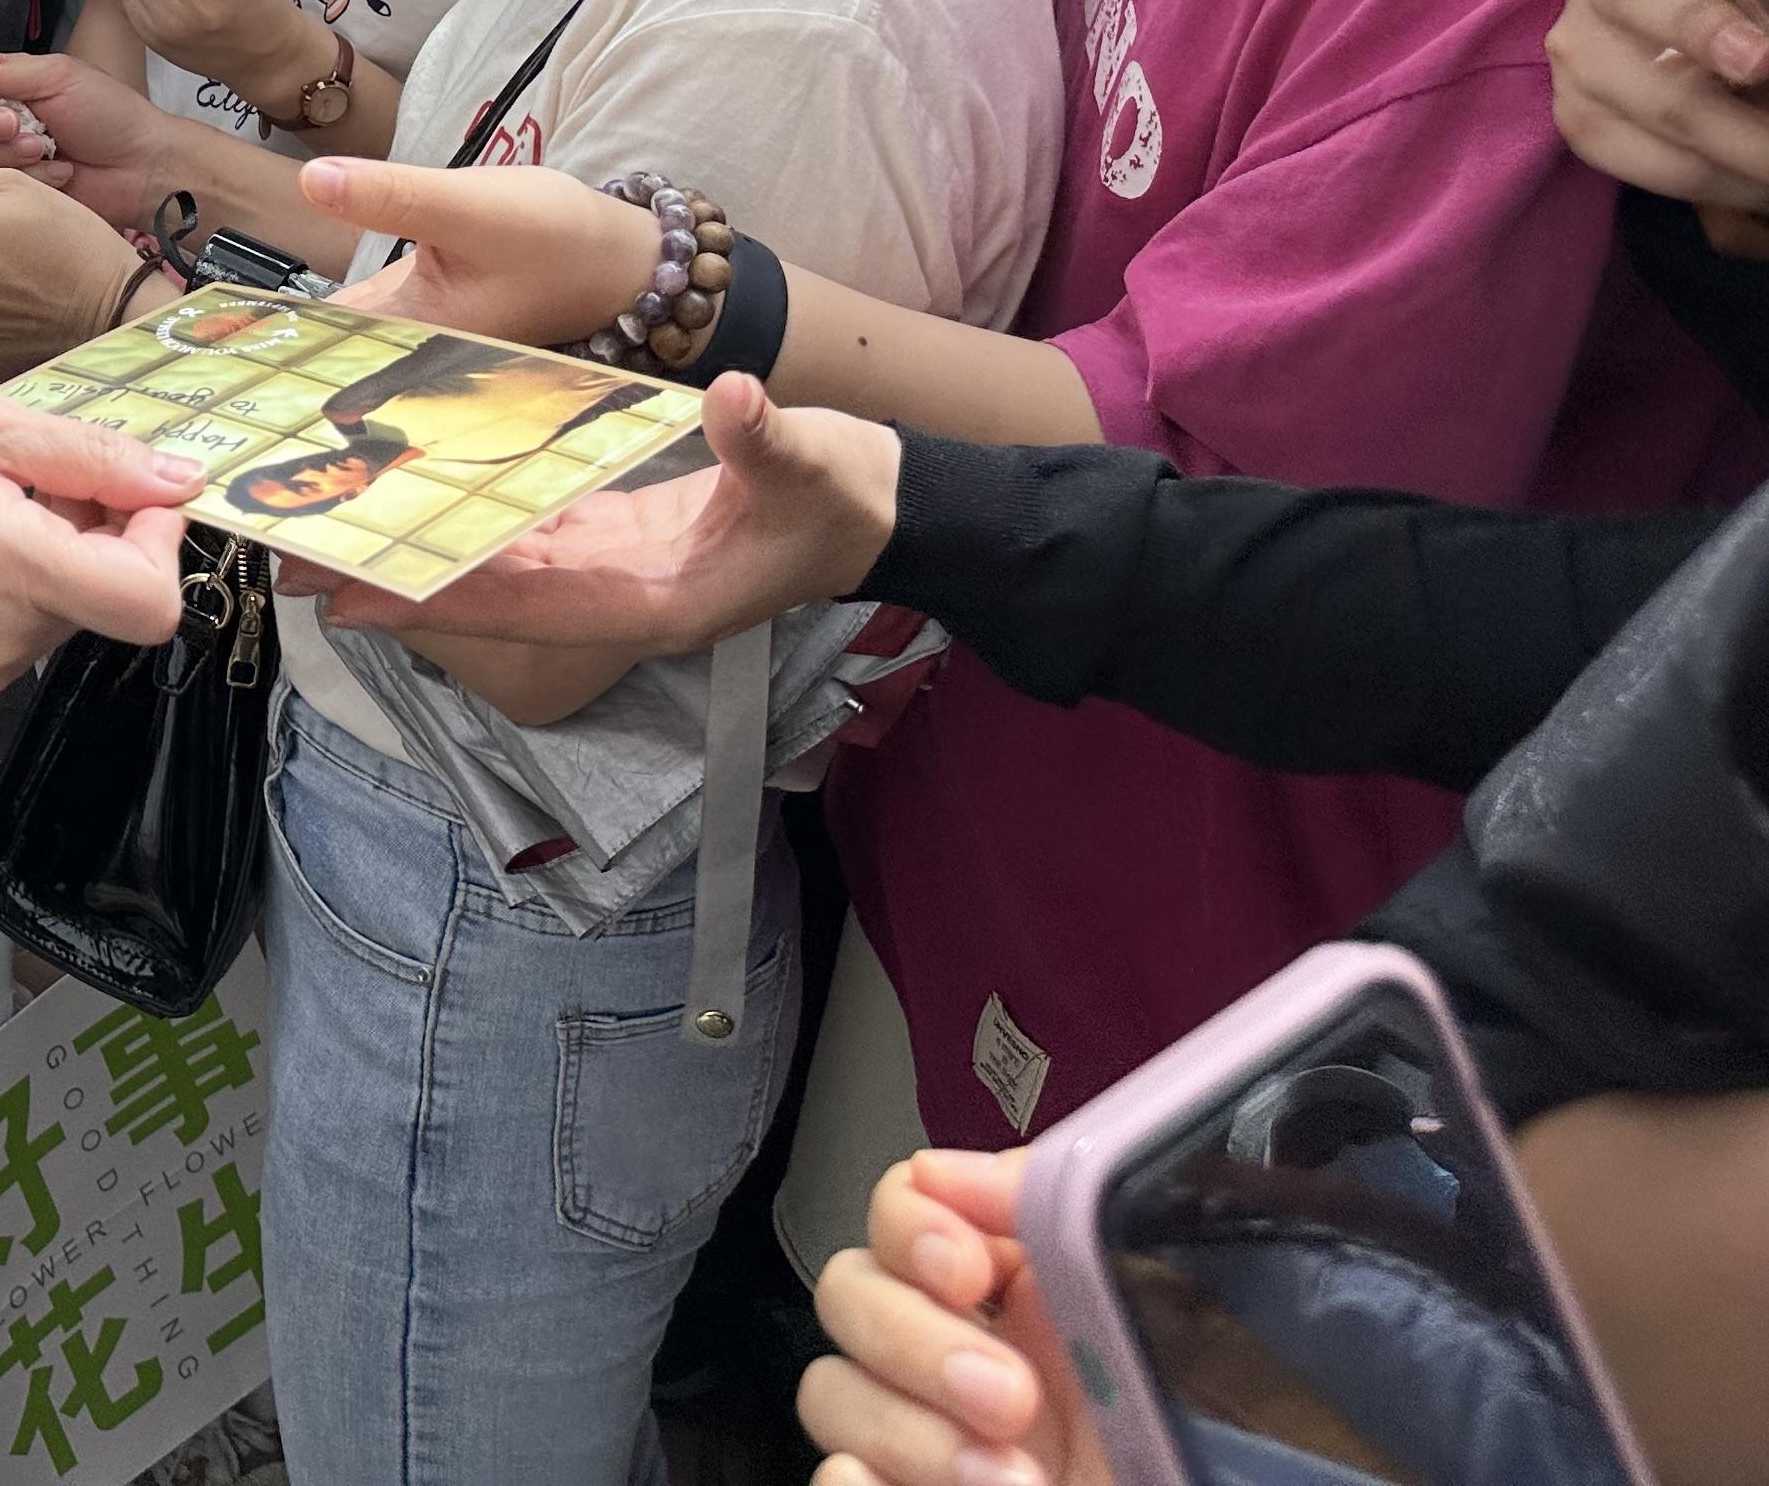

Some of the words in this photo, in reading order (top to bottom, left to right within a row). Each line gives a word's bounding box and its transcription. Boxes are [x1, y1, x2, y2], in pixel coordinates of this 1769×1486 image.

[49, 382, 131, 404] Leslie
[138, 387, 215, 407] your
[230, 400, 258, 416] to
[150, 420, 249, 454] Happy
[72, 989, 261, 1147] 事
